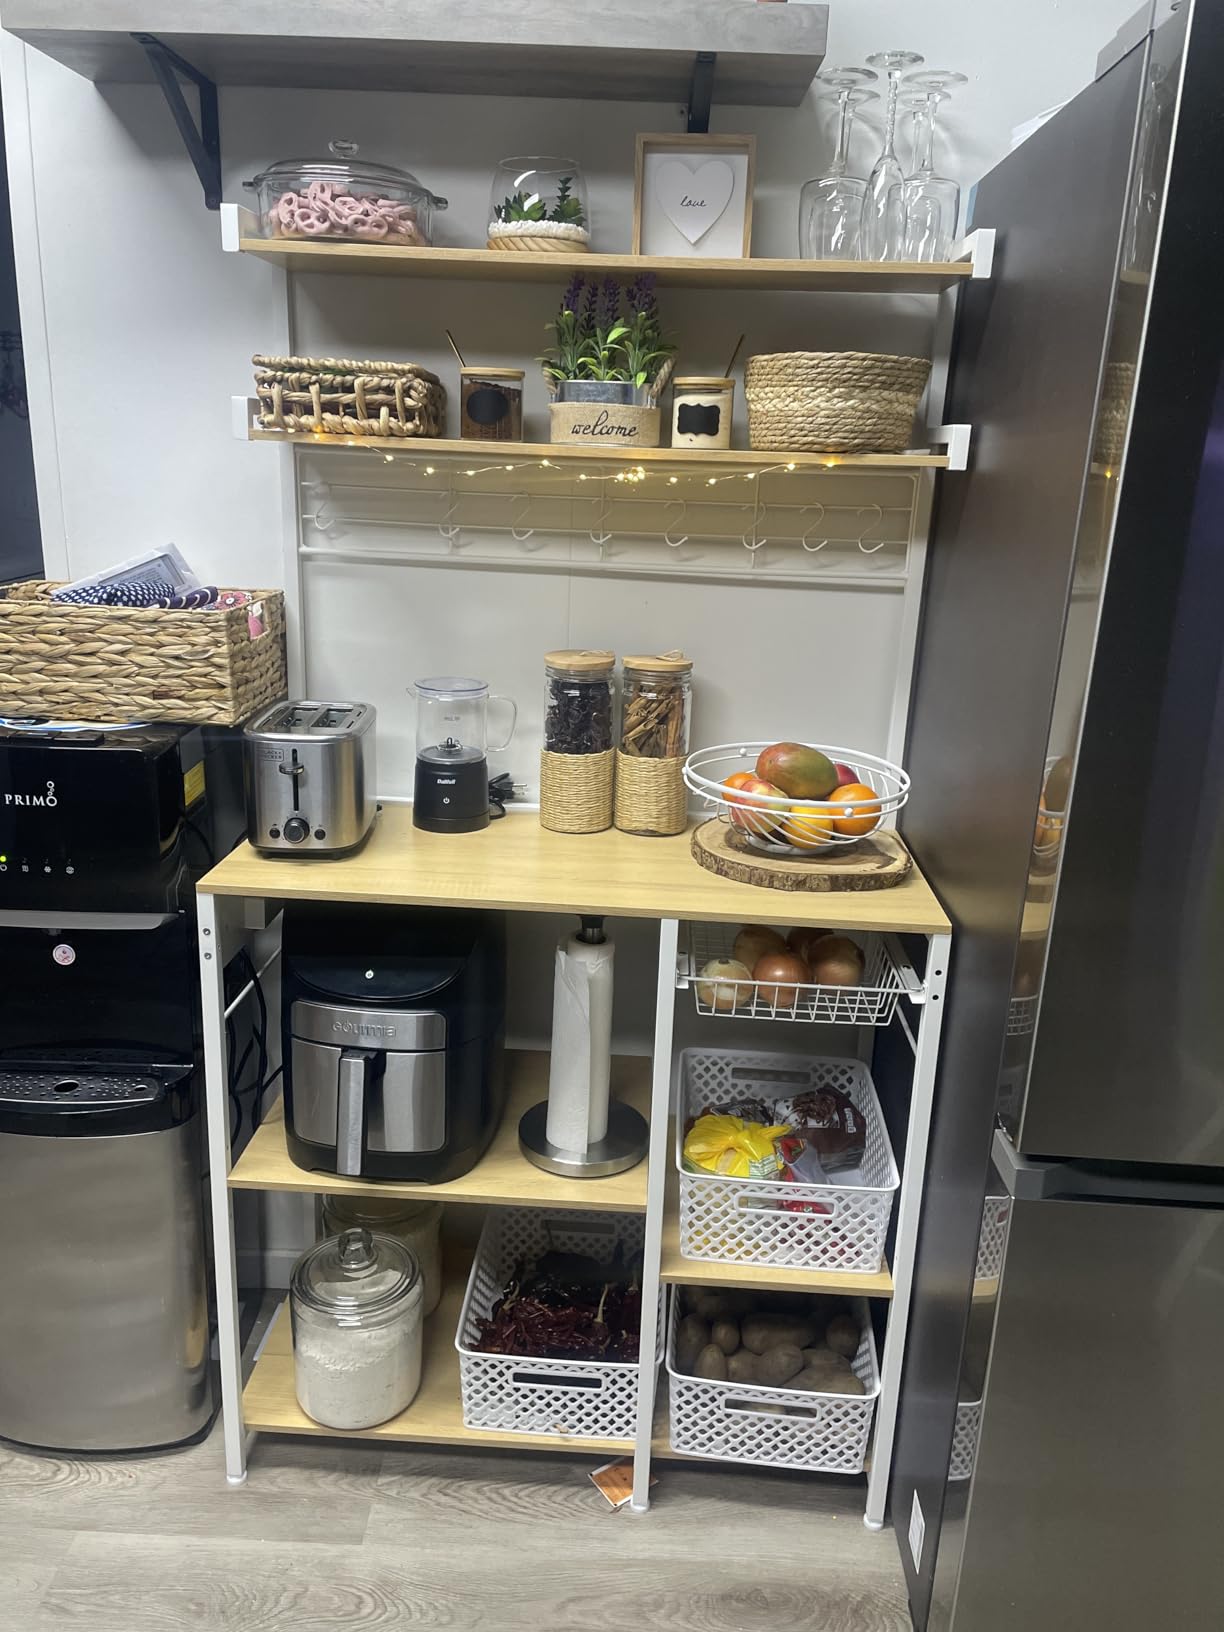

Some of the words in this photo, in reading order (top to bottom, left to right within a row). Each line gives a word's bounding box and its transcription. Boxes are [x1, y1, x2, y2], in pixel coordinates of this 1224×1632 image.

[680, 195, 706, 207] love
[571, 409, 639, 437] welcome
[4, 793, 58, 807] PRIMO
